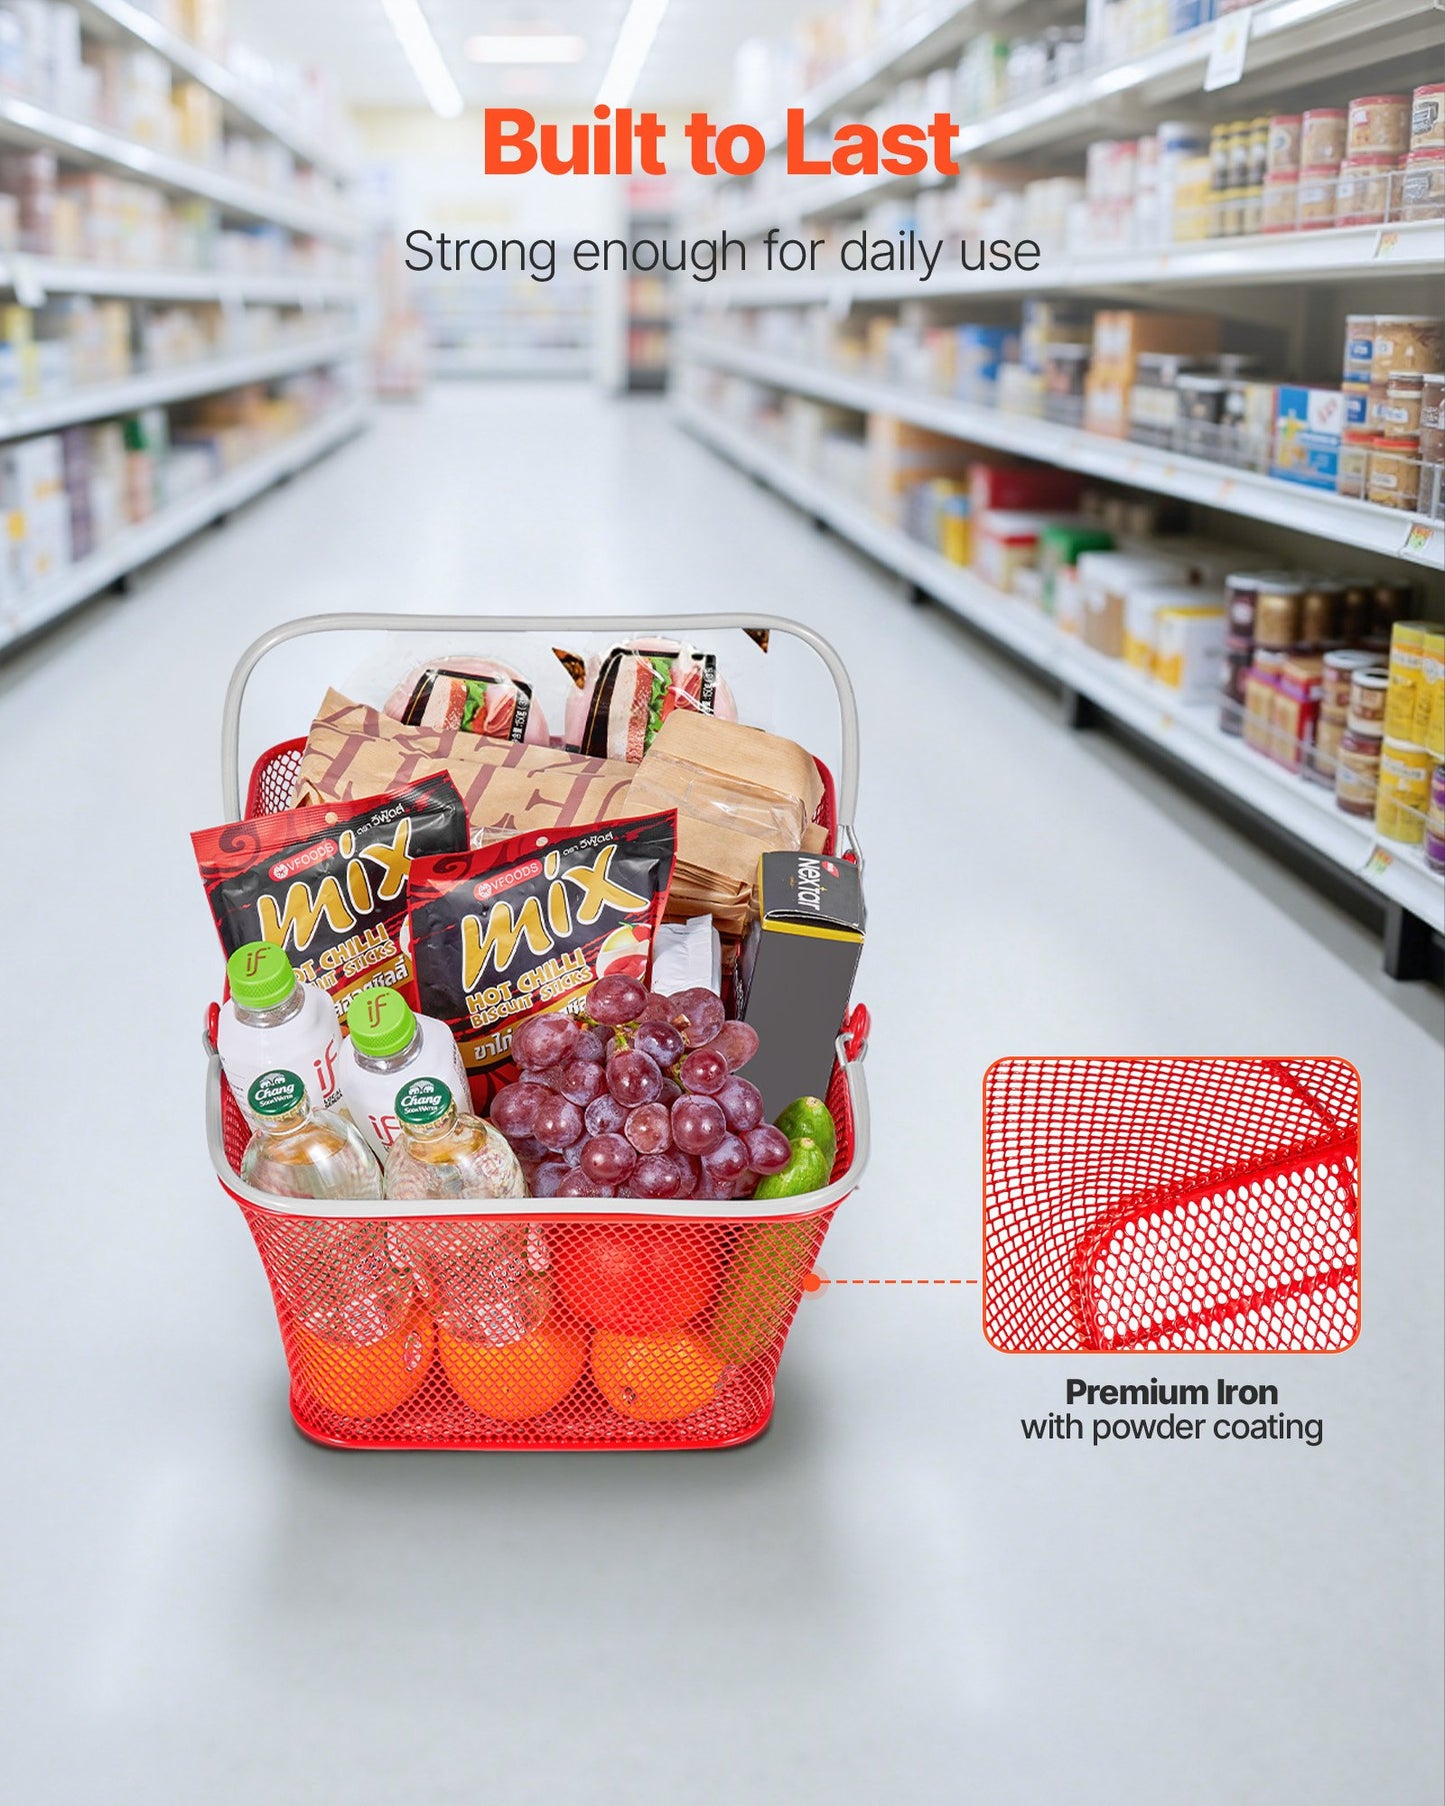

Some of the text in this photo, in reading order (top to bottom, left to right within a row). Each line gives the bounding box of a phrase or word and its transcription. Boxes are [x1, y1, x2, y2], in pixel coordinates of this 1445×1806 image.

[287, 842, 335, 872] VFOODS
[490, 862, 540, 891] VFOODS
[257, 817, 412, 952] mix
[461, 844, 651, 993] mix
[319, 922, 389, 970] CHILLI
[342, 940, 398, 978] STICKS
[465, 947, 587, 1015] HOT CHILLI
[469, 993, 534, 1029] BISCUIT
[540, 965, 594, 1002] STICKS
[254, 1083, 295, 1101] Chang
[400, 1095, 442, 1107] Chang
